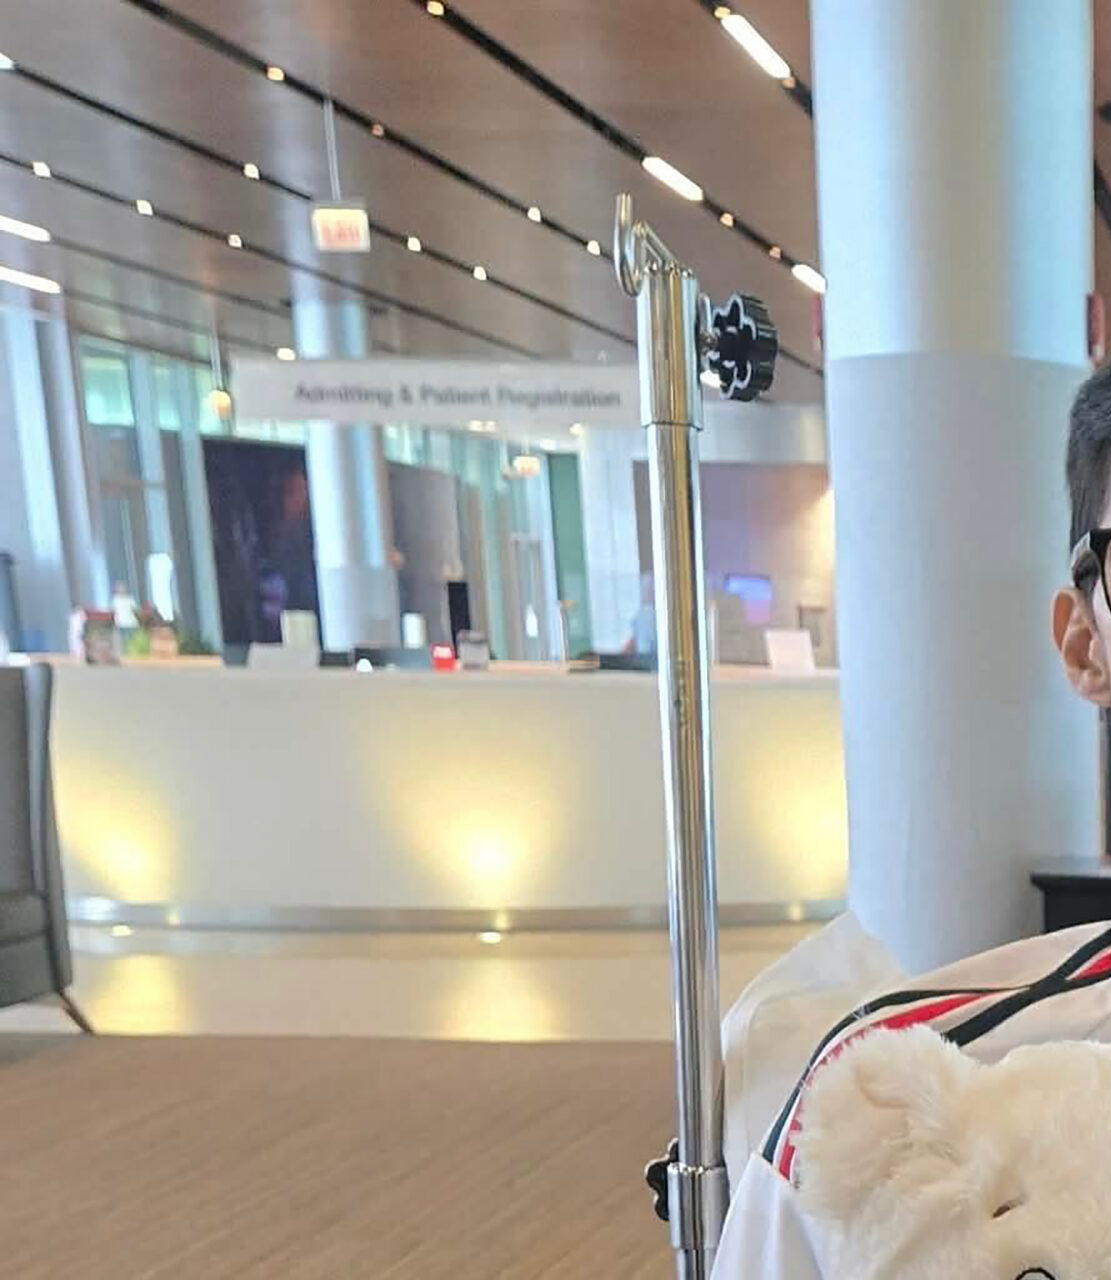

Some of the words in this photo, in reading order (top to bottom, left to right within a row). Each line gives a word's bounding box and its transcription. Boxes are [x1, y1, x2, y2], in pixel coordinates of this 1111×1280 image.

[295, 380, 393, 409] Admitting
[401, 382, 413, 405] &
[420, 382, 490, 406] Patient
[497, 384, 621, 411] Registration
